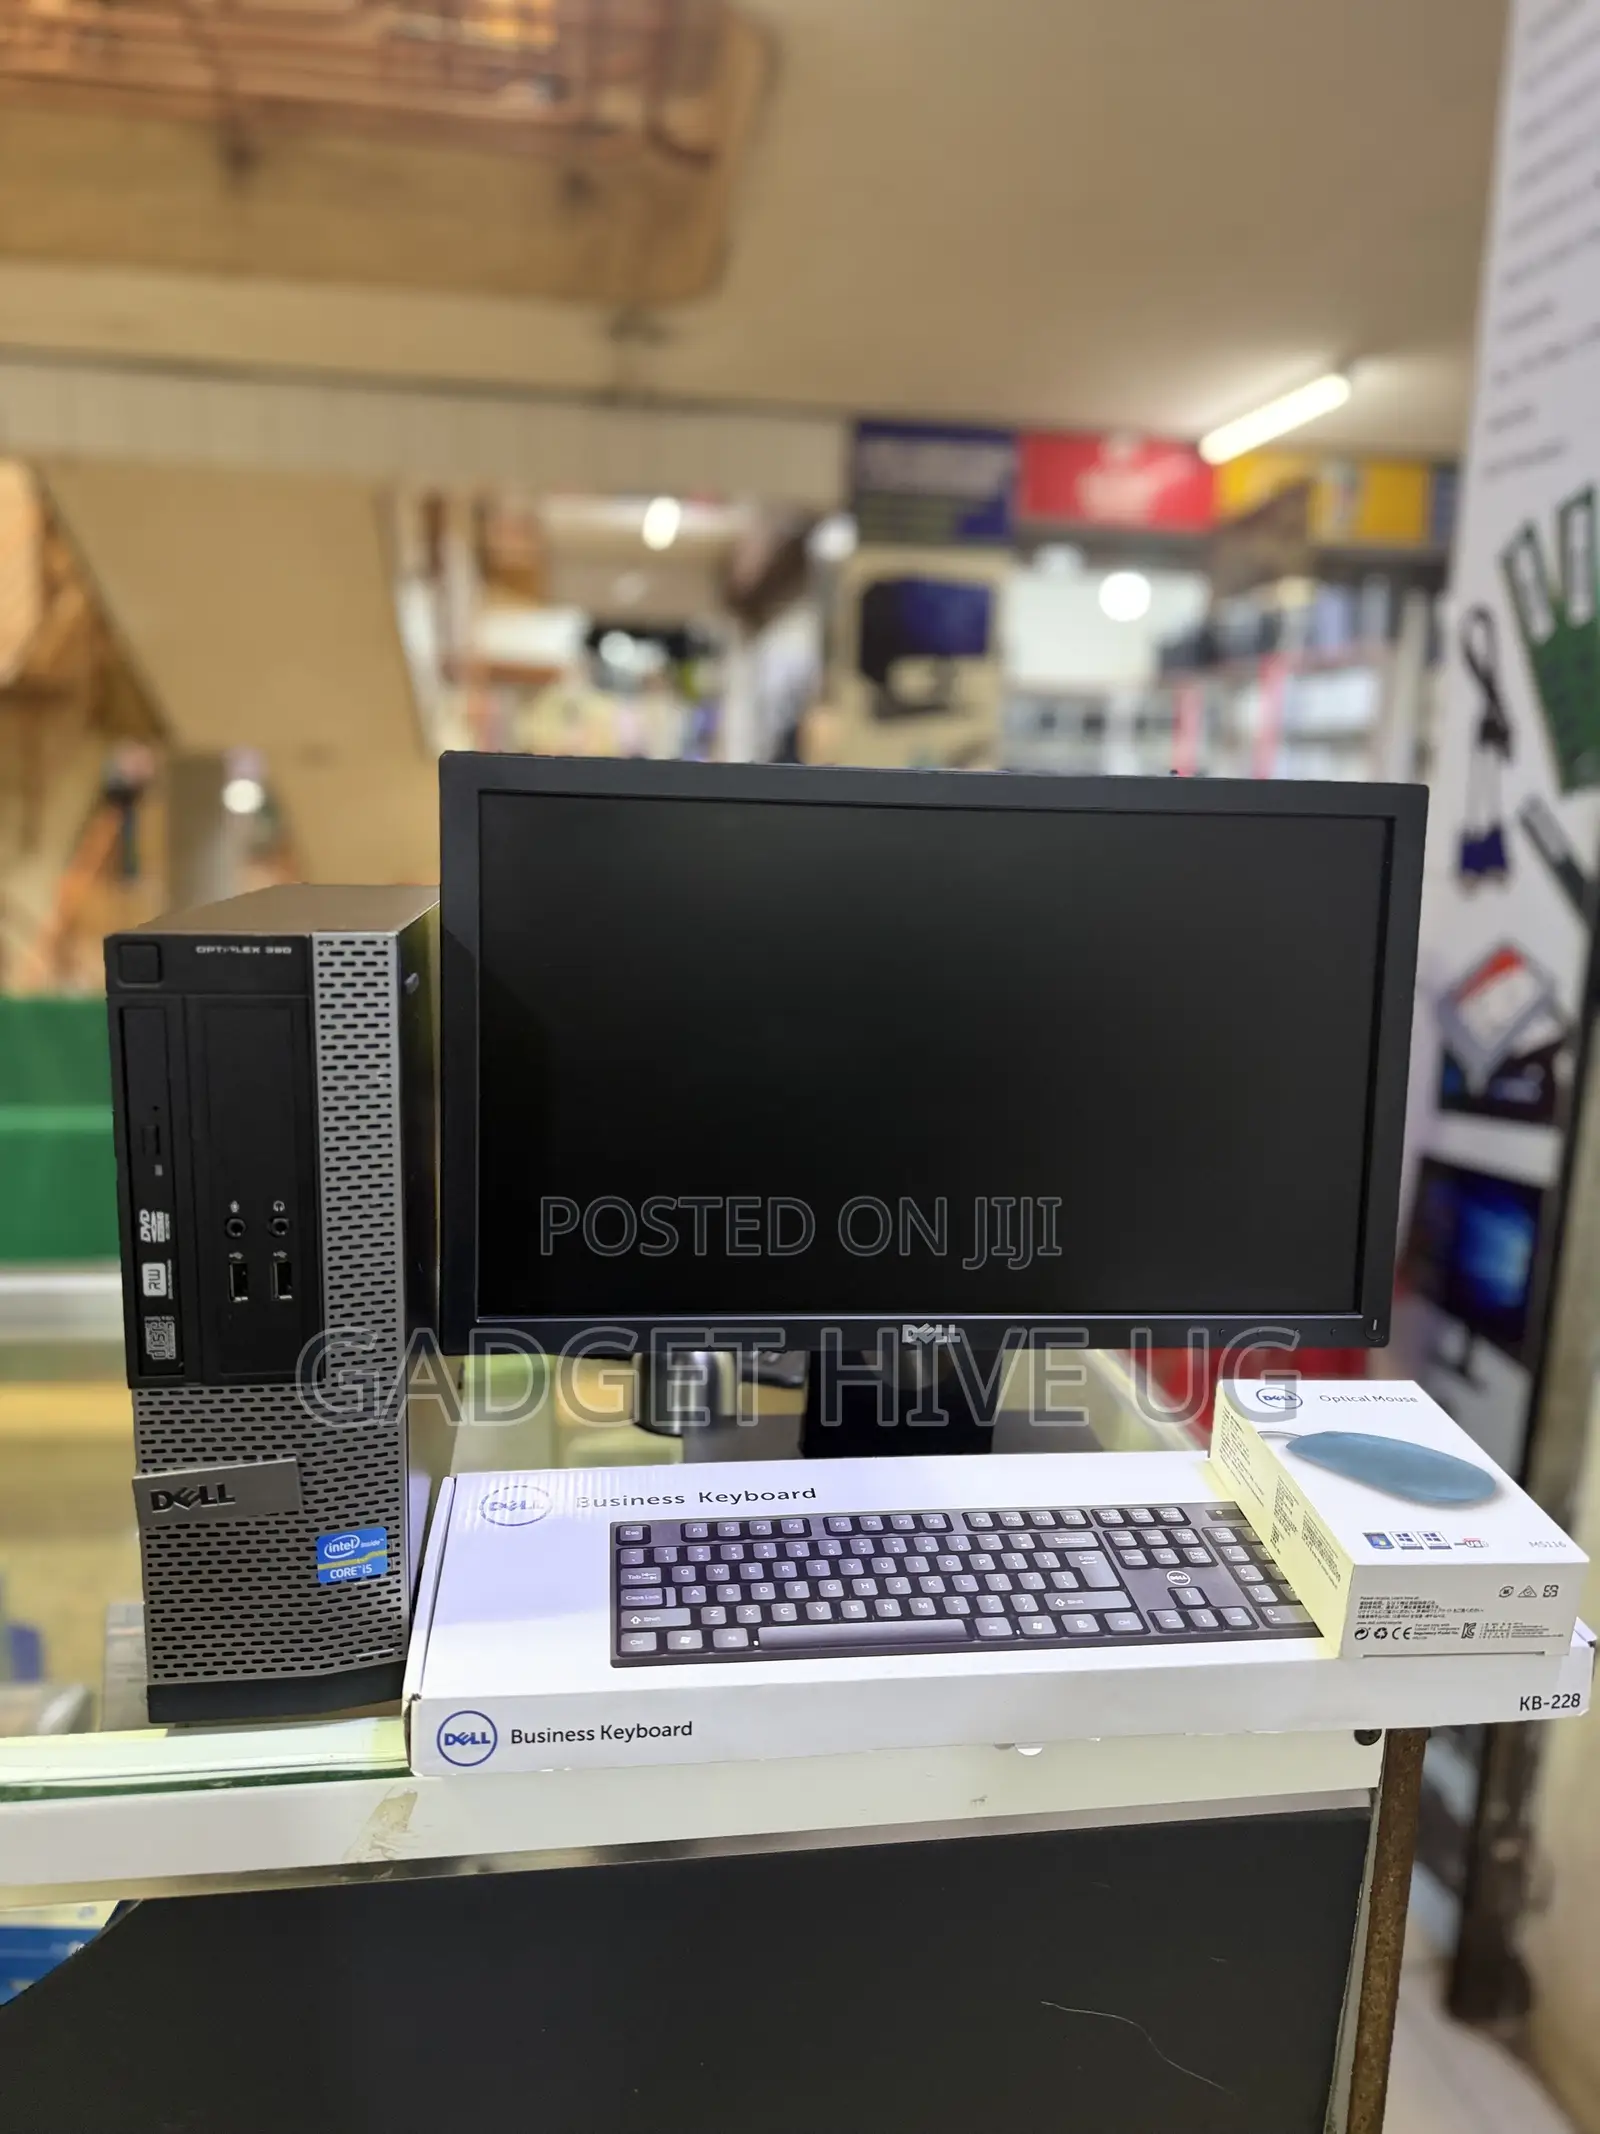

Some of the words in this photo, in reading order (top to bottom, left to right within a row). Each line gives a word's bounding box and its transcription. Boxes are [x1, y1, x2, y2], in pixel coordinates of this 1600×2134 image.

[139, 1208, 151, 1242] DVD
[902, 1323, 960, 1344] DELL
[1319, 1394, 1371, 1403] Optical
[1372, 1395, 1419, 1403] Mouse
[150, 1483, 236, 1513] DELL
[576, 1493, 685, 1509] Business
[699, 1487, 817, 1506] Keyboard
[330, 1566, 358, 1579] CORE
[362, 1564, 373, 1574] i5
[1519, 1693, 1581, 1711] KB-228
[444, 1731, 491, 1746] DELL
[511, 1727, 595, 1744] Business
[601, 1721, 693, 1742] Keyboard
